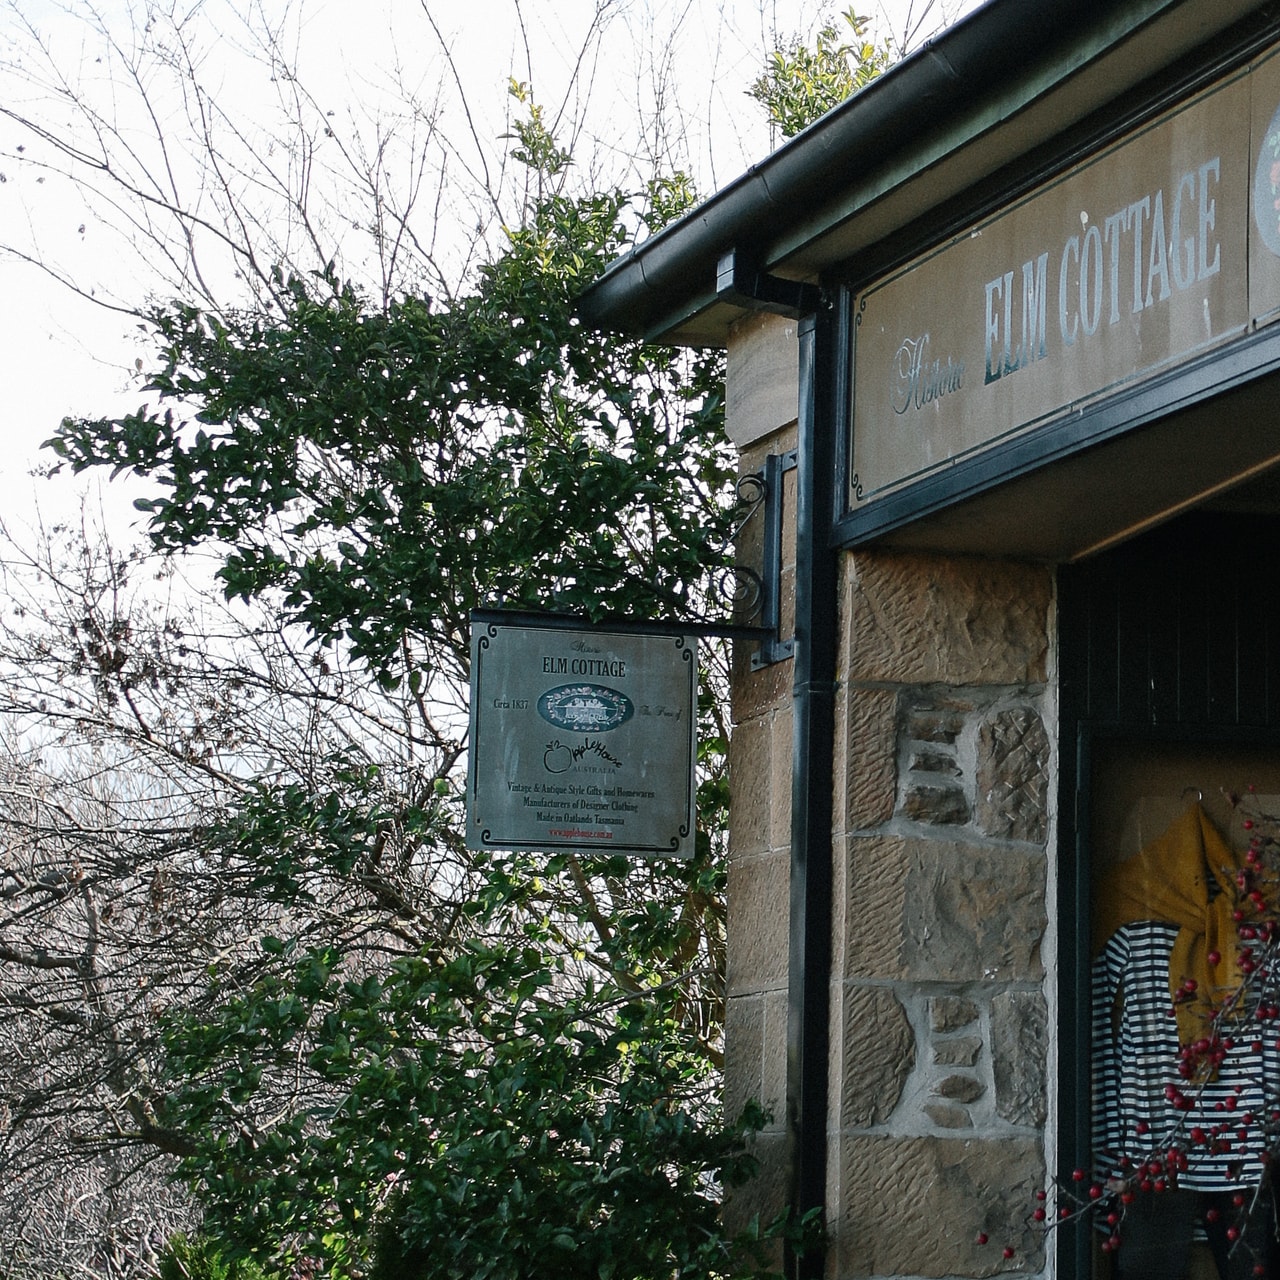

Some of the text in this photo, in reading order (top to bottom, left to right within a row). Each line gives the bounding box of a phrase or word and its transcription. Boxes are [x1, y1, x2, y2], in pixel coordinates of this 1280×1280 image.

[983, 251, 1049, 387] ELM
[1058, 157, 1221, 347] COTTAGE
[542, 656, 626, 678] ELM COTTAGE
[512, 699, 529, 710] 1837
[573, 766, 617, 775] AUSTRALIA
[507, 781, 655, 799] Vintage & Antique Style Gifts and Homewares
[523, 796, 638, 813] Manufacturers of Designer Clothing
[536, 812, 625, 825] Made in Oatlands Tasmania
